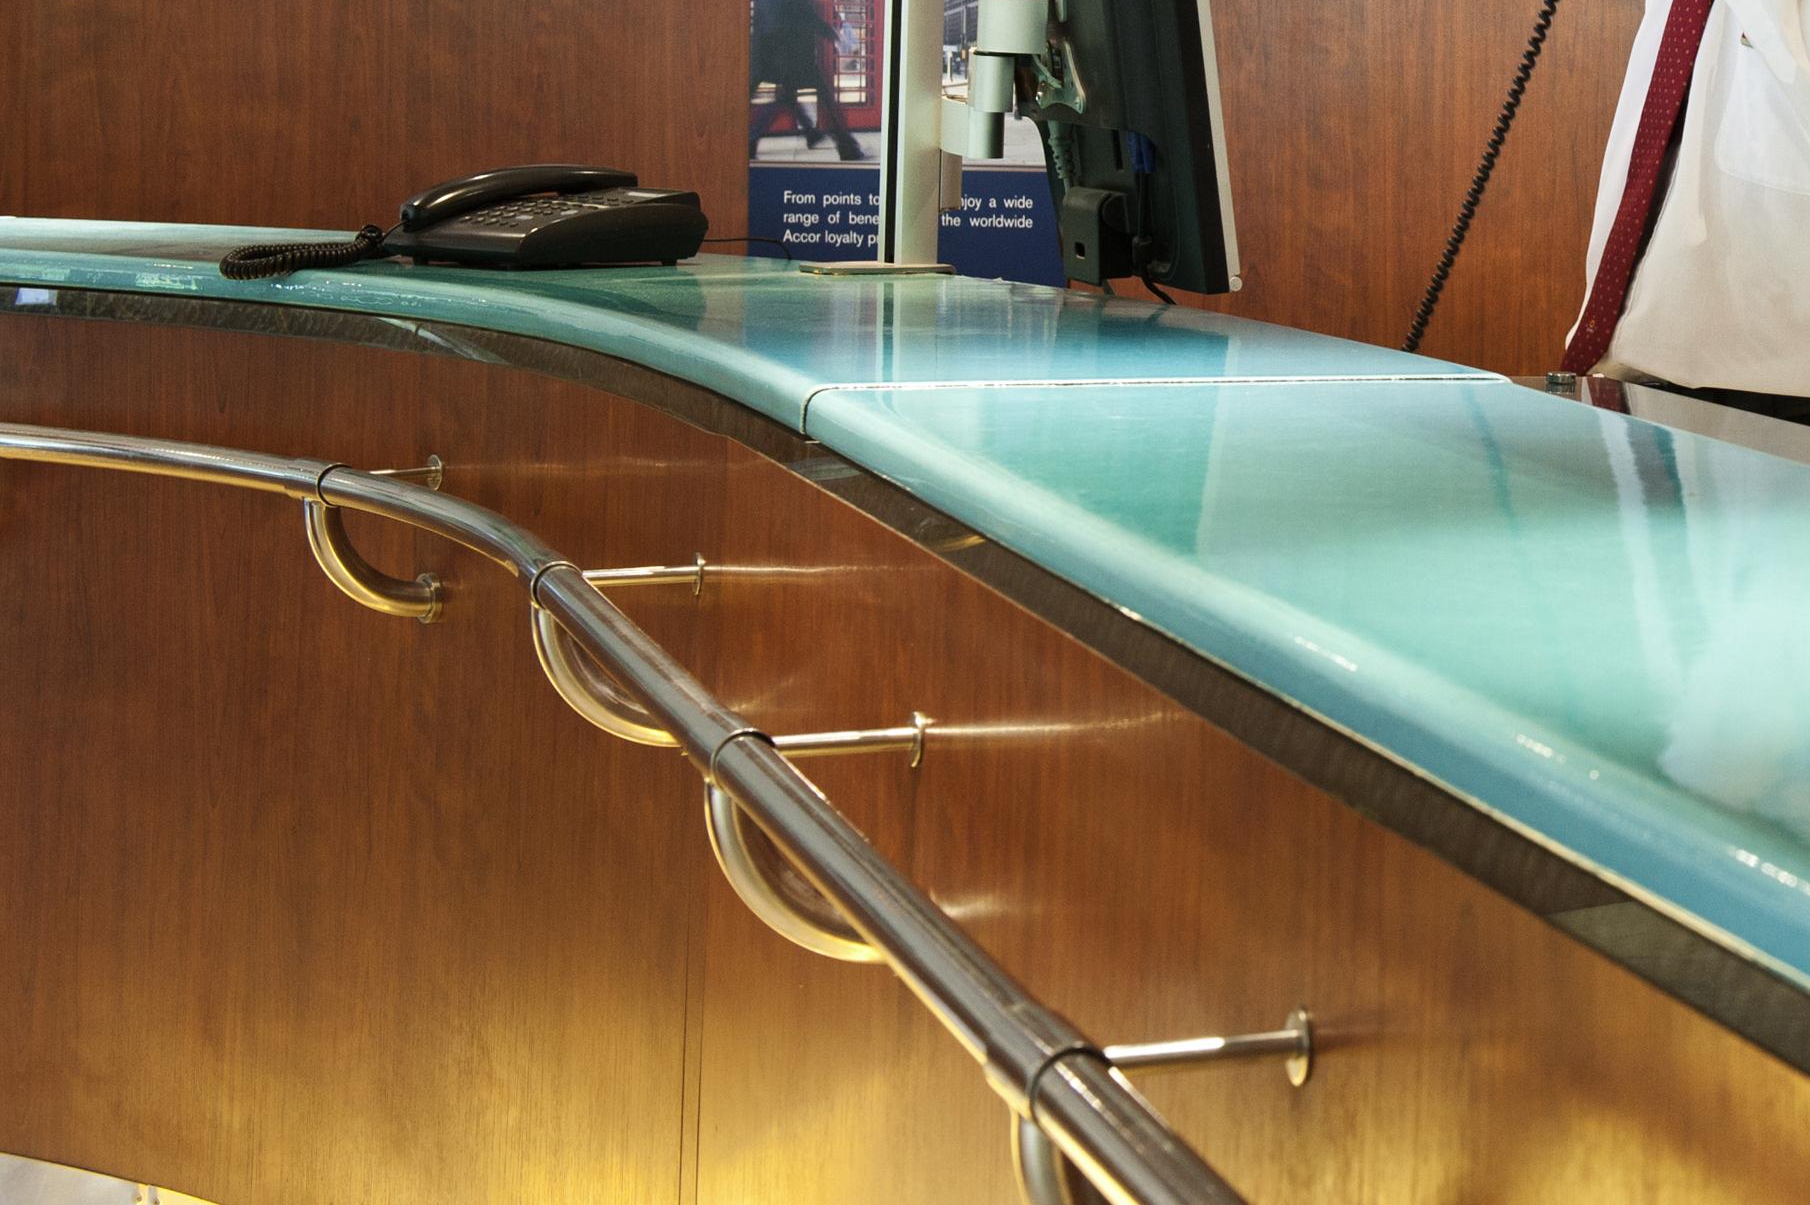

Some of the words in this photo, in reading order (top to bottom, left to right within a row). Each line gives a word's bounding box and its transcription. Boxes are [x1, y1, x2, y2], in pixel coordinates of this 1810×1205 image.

[783, 190, 816, 204] From
[823, 191, 862, 208] points
[988, 197, 997, 208] a
[1003, 195, 1033, 209] wide
[783, 213, 819, 227] range
[827, 211, 840, 224] of
[941, 213, 961, 227] the
[969, 214, 1033, 229] worldwide
[783, 229, 821, 243] Accor
[825, 230, 864, 247] loyalty
